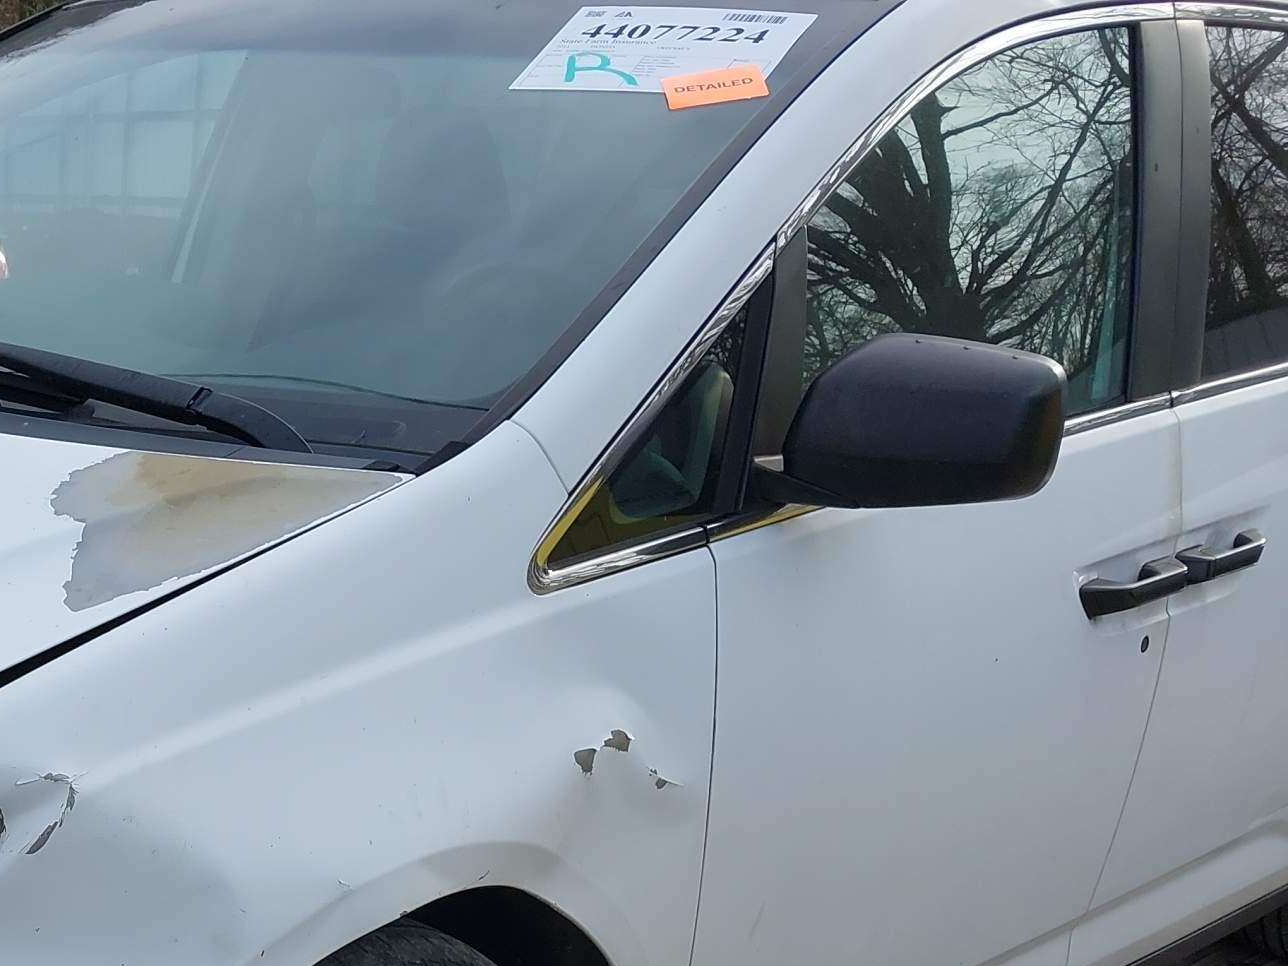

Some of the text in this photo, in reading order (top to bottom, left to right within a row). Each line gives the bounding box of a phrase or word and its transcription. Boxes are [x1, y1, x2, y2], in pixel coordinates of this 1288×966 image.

[581, 23, 769, 44] 44077224
[564, 51, 638, 86] R
[673, 77, 754, 94] DETAILED
